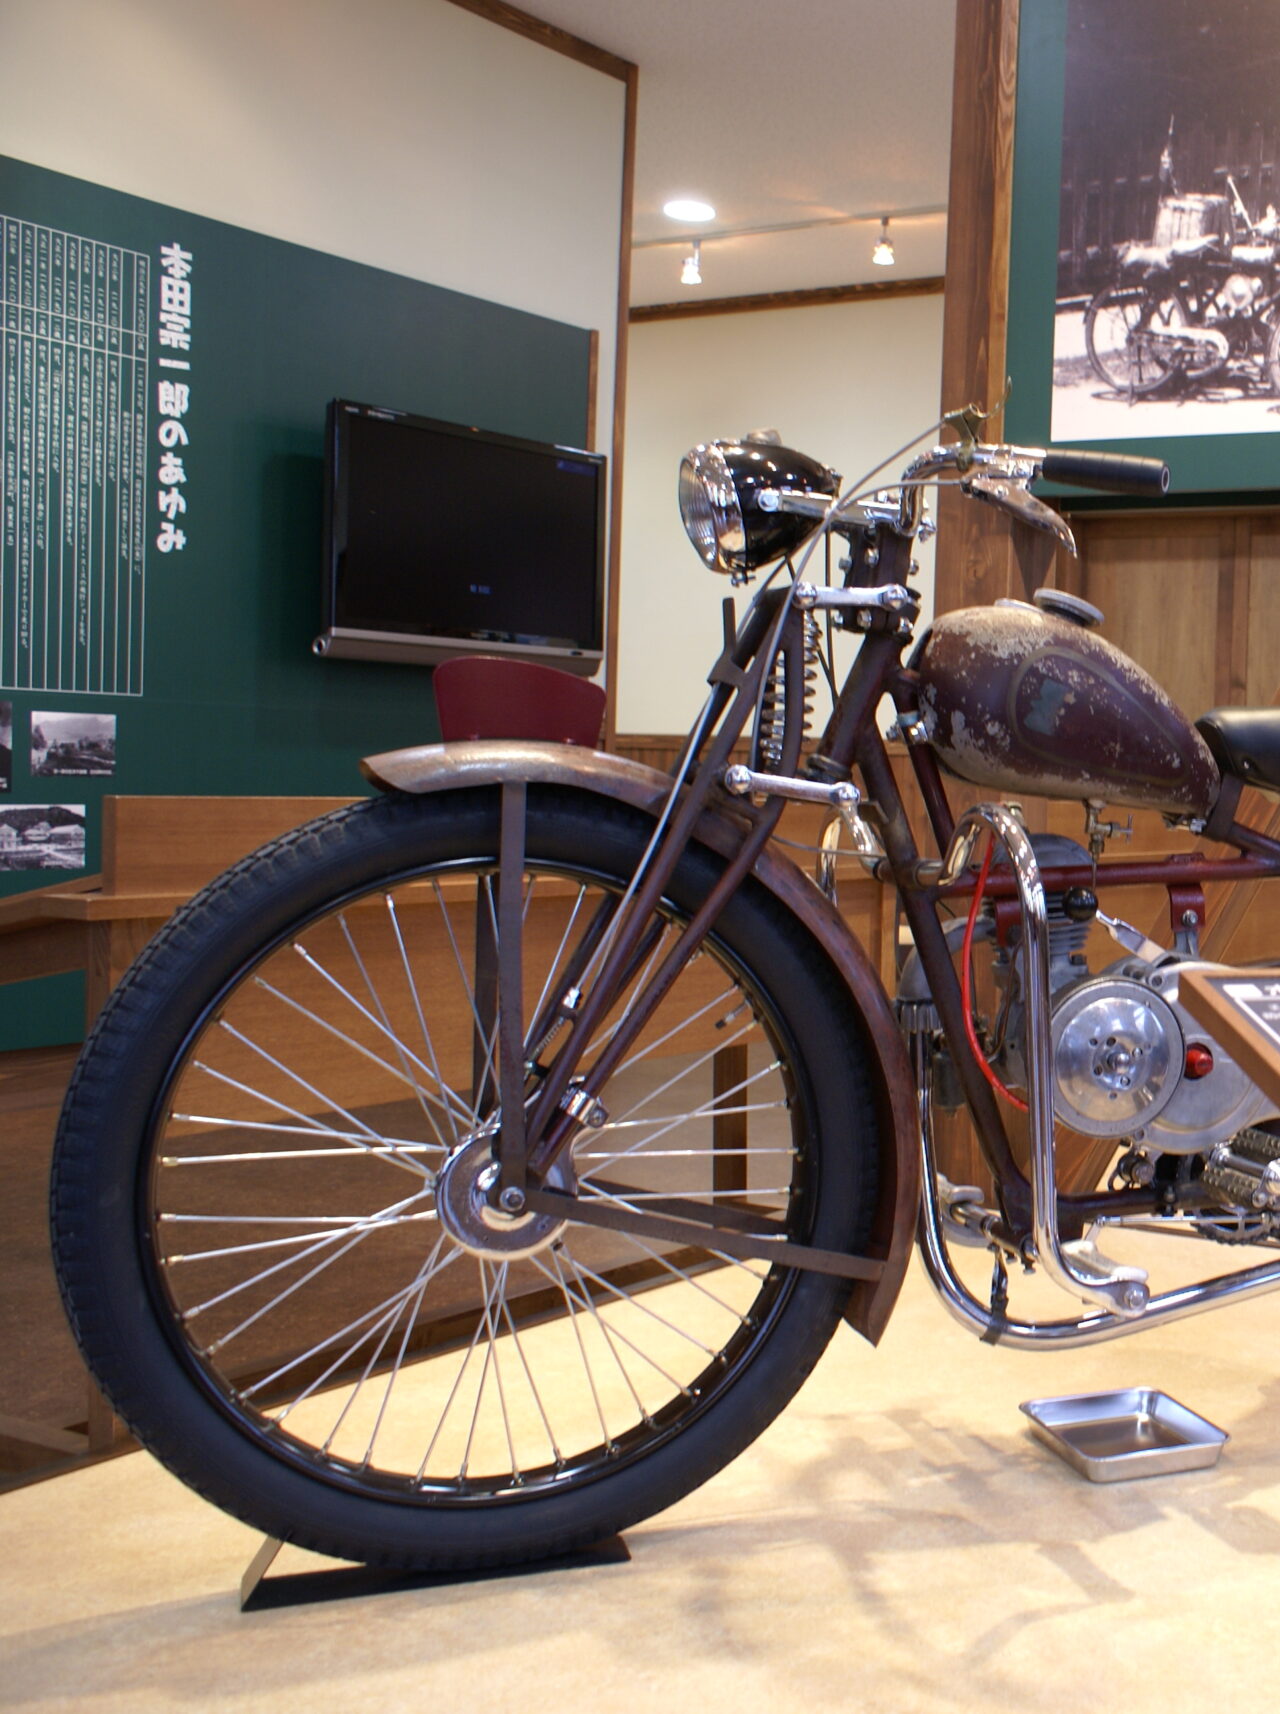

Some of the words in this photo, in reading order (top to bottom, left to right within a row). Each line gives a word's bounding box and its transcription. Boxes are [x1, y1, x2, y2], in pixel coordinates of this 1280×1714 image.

[157, 242, 193, 553] 本田宗一郎のあゆみ
